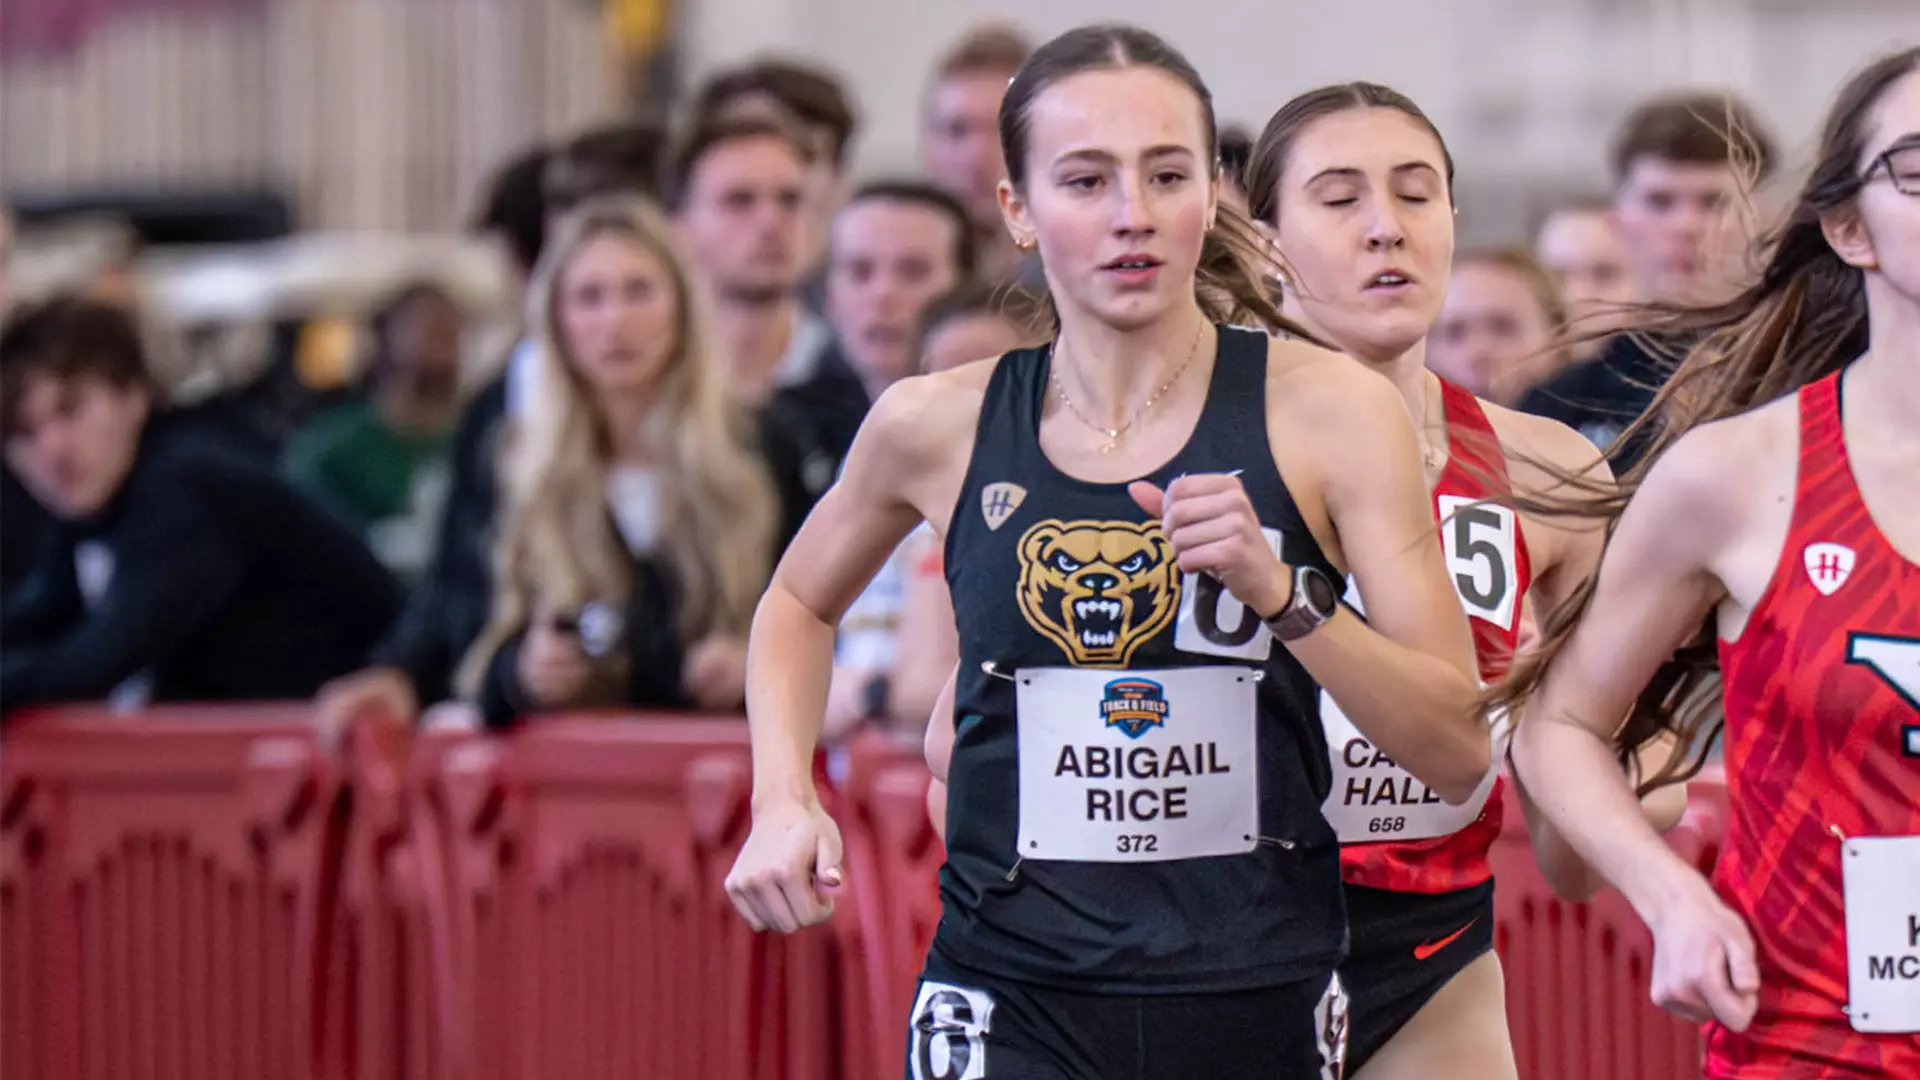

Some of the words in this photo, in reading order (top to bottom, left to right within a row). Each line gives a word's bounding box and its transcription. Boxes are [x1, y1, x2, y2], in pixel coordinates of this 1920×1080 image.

[1453, 504, 1507, 611] 5
[1054, 742, 1231, 778] ABIGAIL
[1343, 737, 1396, 768] CA
[1086, 787, 1188, 821] RICE
[1343, 777, 1440, 806] HALL
[1369, 816, 1406, 833] 658
[1117, 835, 1158, 853] 372
